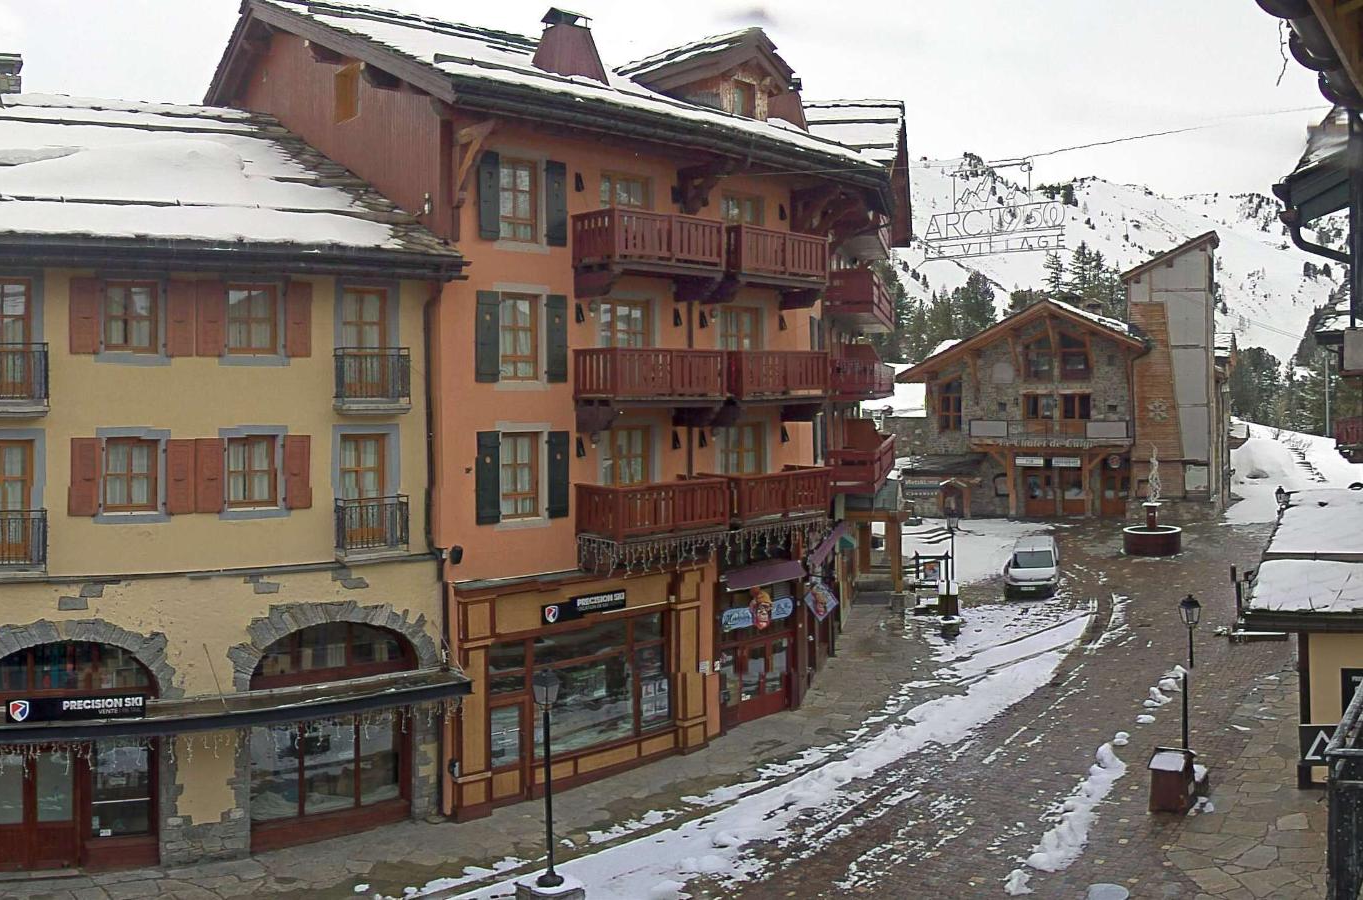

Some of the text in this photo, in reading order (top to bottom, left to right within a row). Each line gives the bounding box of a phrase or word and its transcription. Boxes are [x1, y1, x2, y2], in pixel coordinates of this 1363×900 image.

[925, 208, 984, 240] ARC
[961, 234, 1066, 256] VILLAGE
[1015, 438, 1047, 448] Chalet
[62, 696, 143, 710] PRECISION SKI
